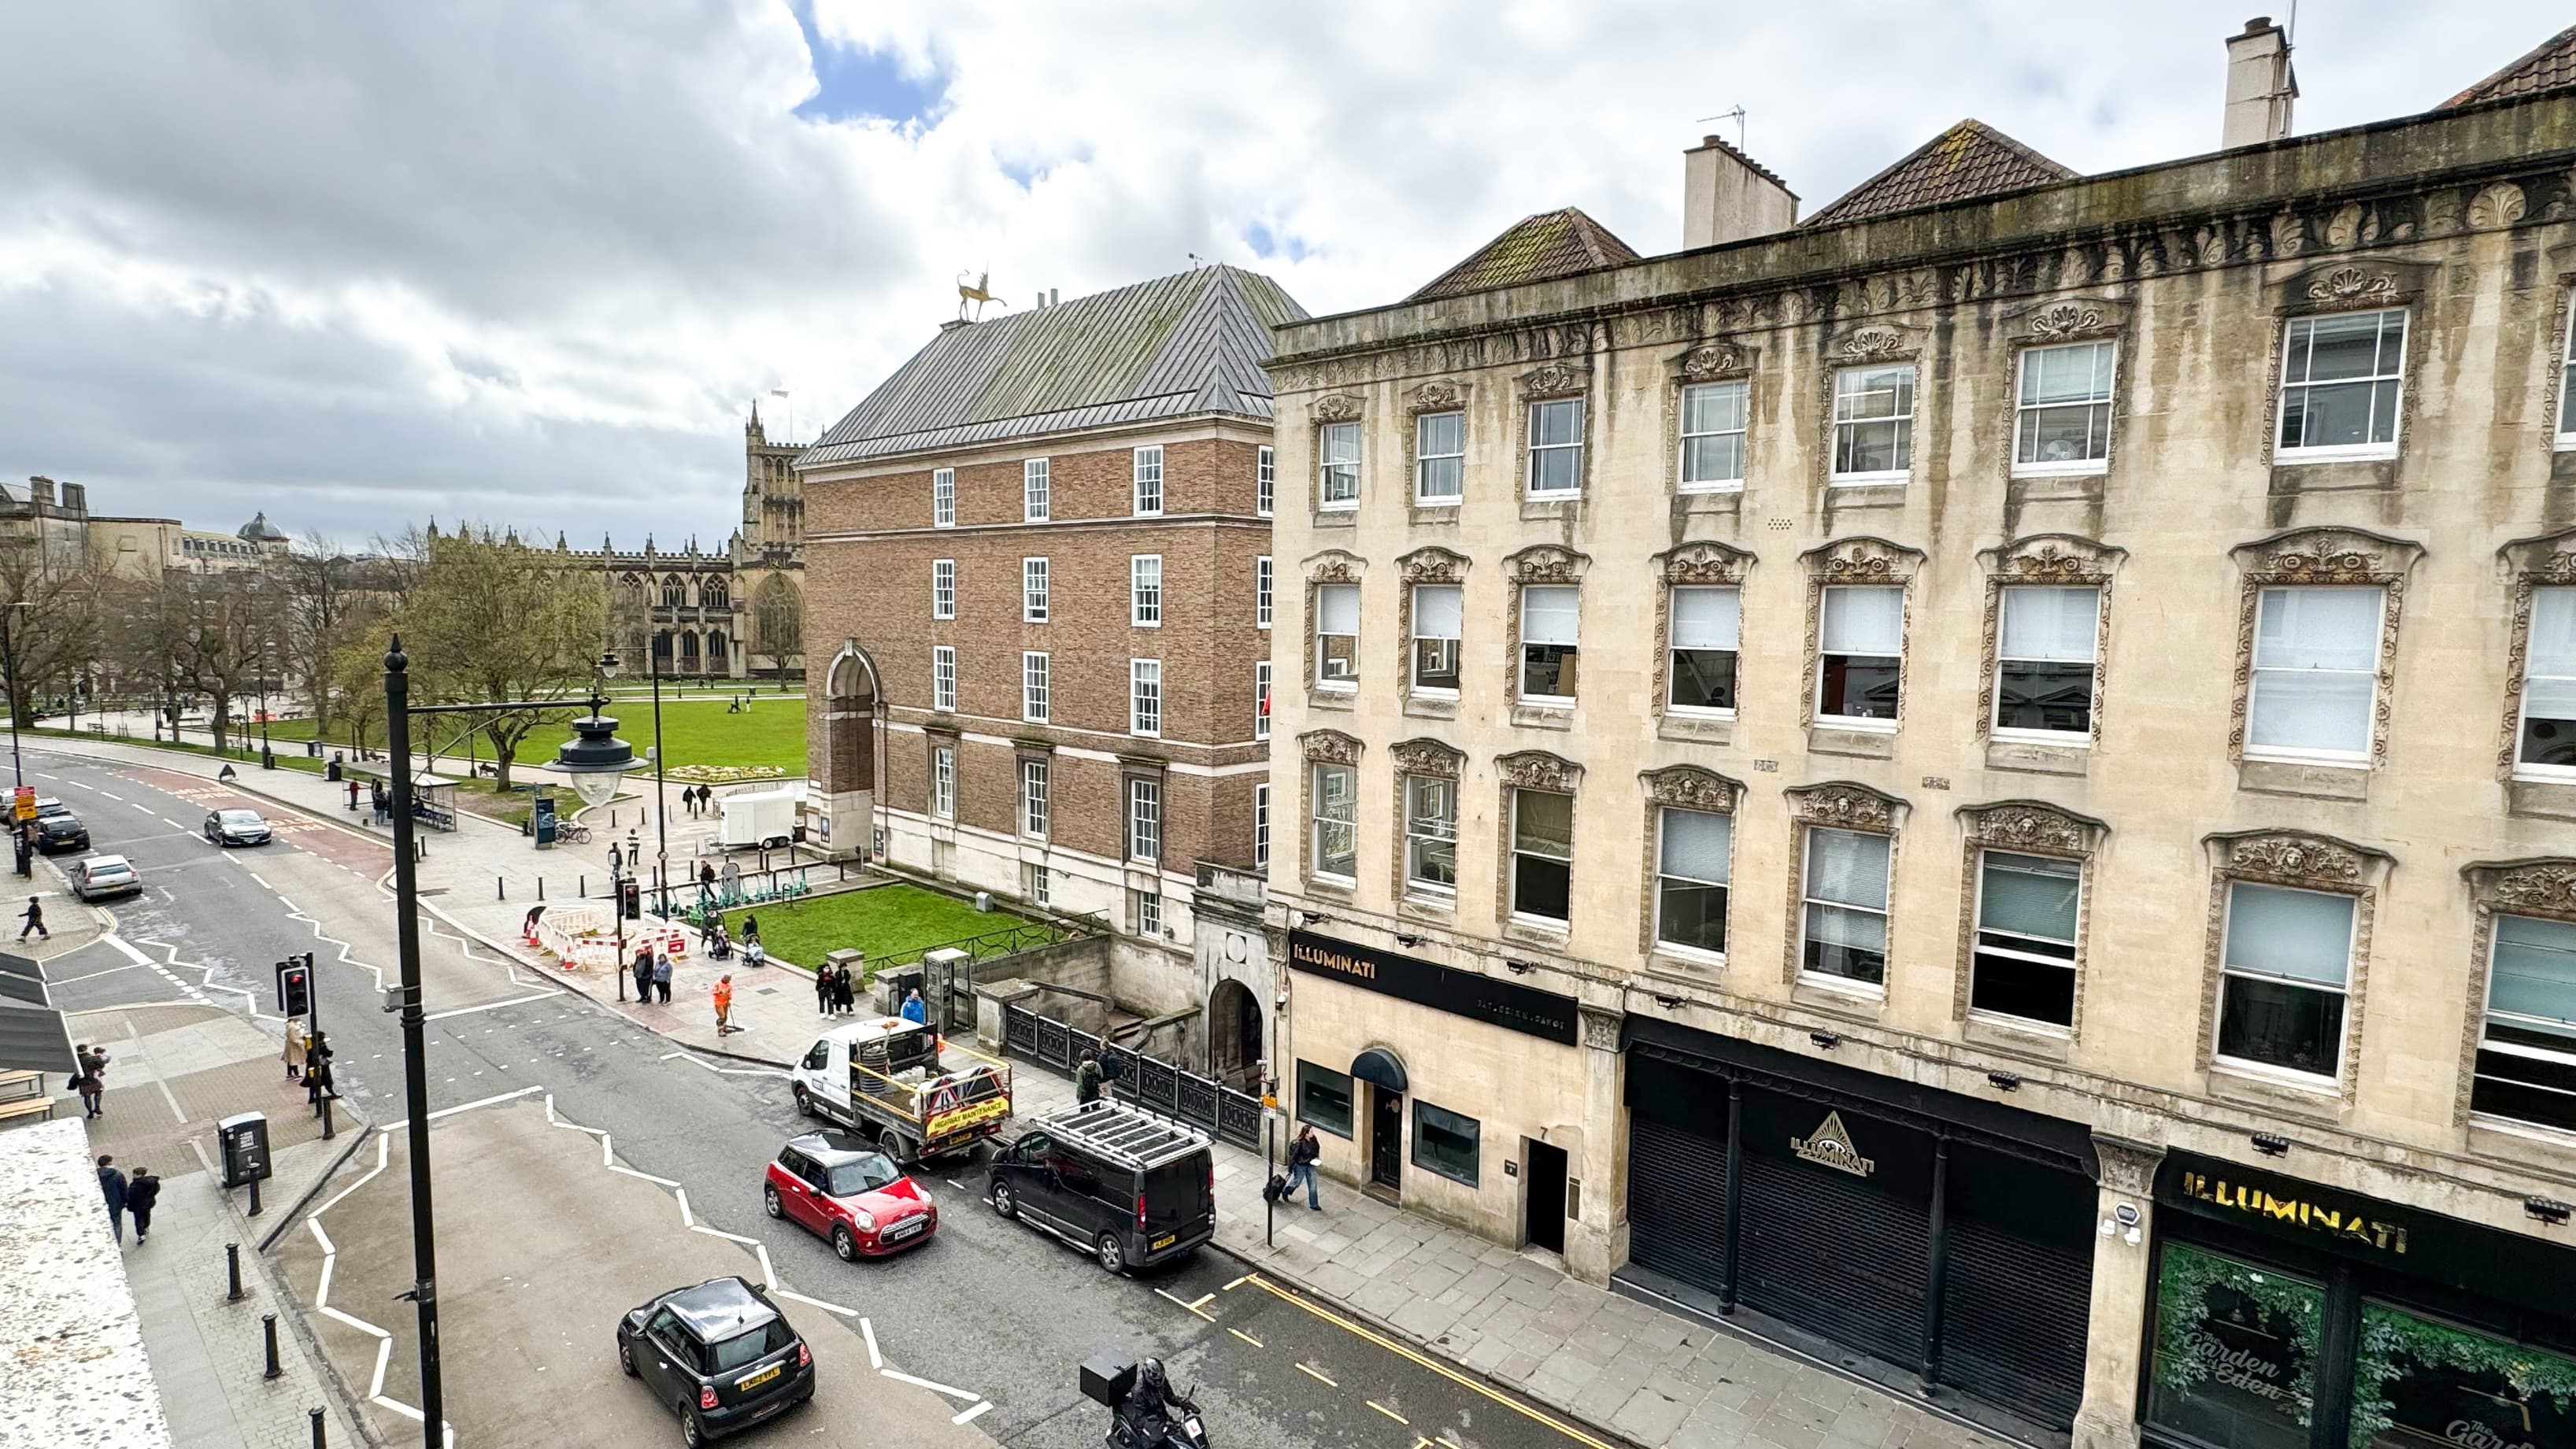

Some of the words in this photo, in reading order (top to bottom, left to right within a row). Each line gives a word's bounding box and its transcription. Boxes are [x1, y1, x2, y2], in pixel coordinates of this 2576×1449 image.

[265, 817, 315, 826] STO
[273, 824, 326, 834] BUS
[1294, 944, 1375, 979] ILLUMINATI
[935, 1116, 960, 1129] HIGHWAY
[963, 1102, 1002, 1119] MAINTENANCE
[1540, 1126, 1549, 1140] 7
[1790, 1137, 1875, 1172] ILLUMINATI
[2184, 1171, 2408, 1255] ILLUMINATI
[2203, 1331, 2222, 1345] The
[2184, 1332, 2281, 1378] Garden
[2215, 1362, 2281, 1399] Eden
[2471, 1420, 2495, 1436] The
